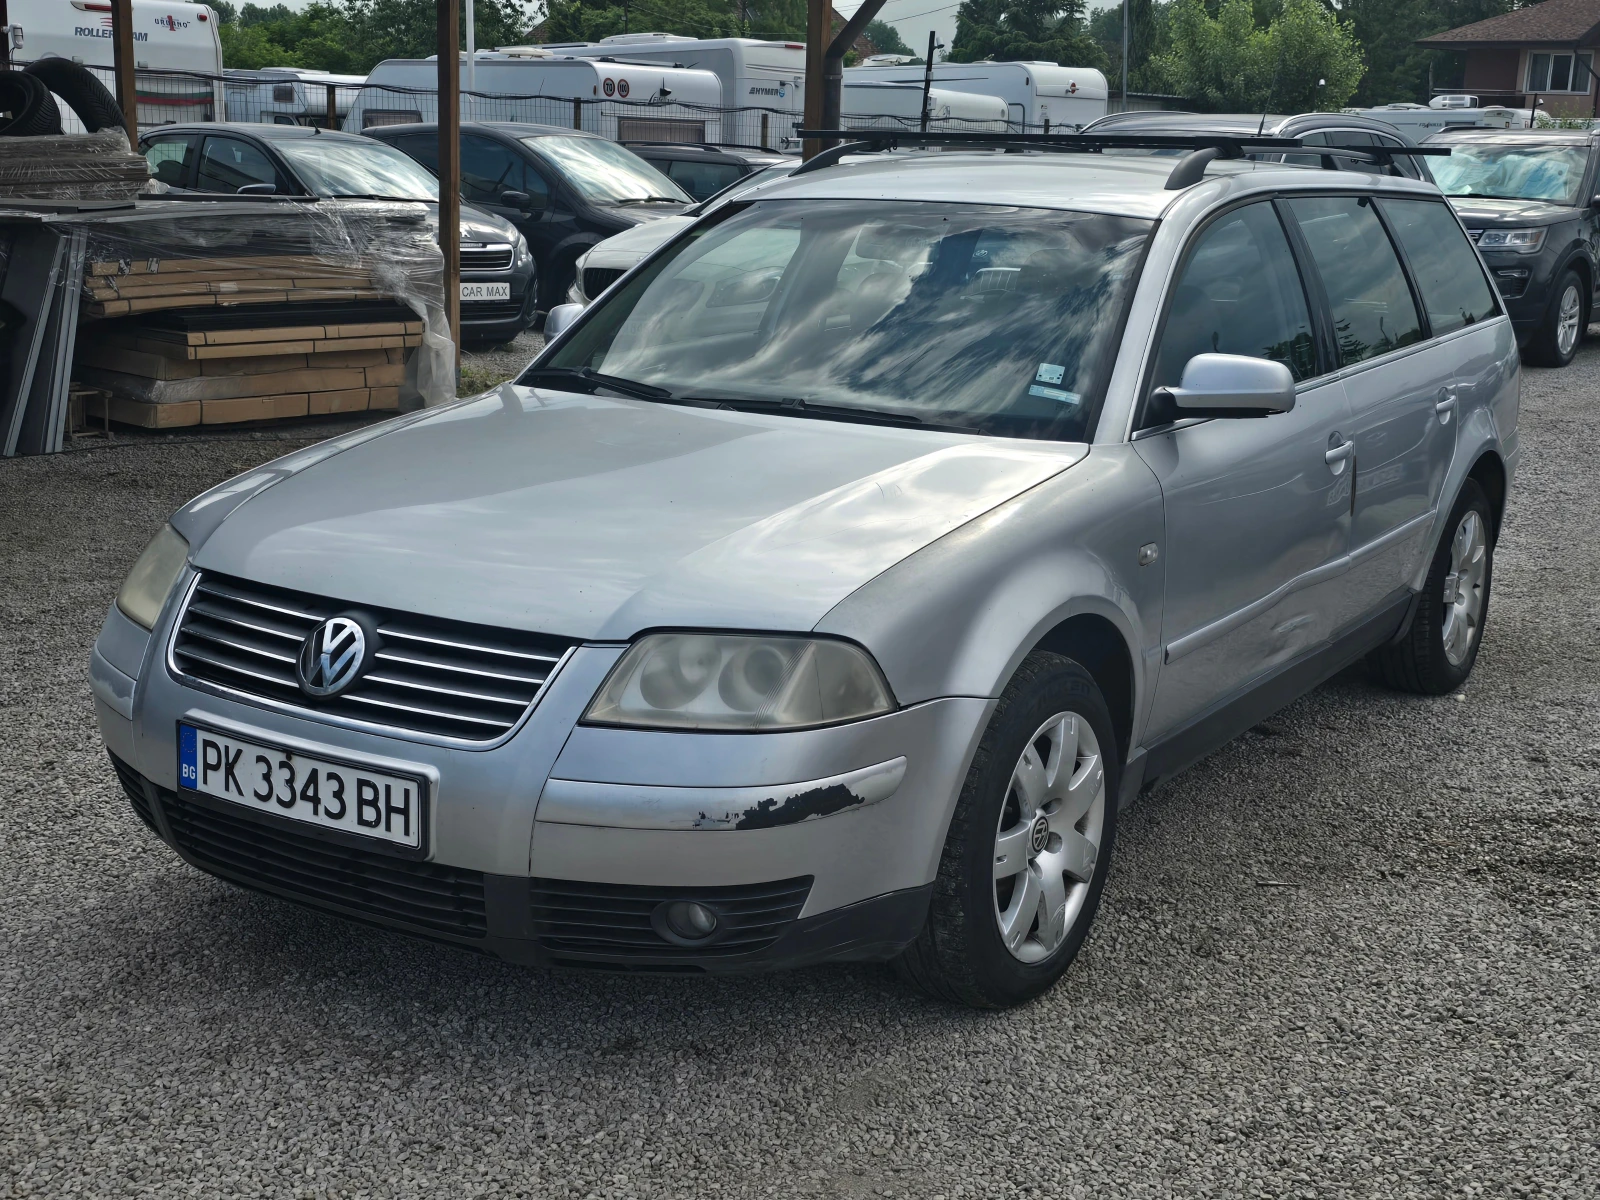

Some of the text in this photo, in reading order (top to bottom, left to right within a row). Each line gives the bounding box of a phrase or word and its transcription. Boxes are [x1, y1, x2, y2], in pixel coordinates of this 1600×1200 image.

[133, 31, 148, 41] AM
[755, 88, 778, 96] HYMER
[462, 286, 508, 297] CAR MAX
[182, 763, 196, 780] BG
[202, 738, 410, 837] PK 3343 BH
